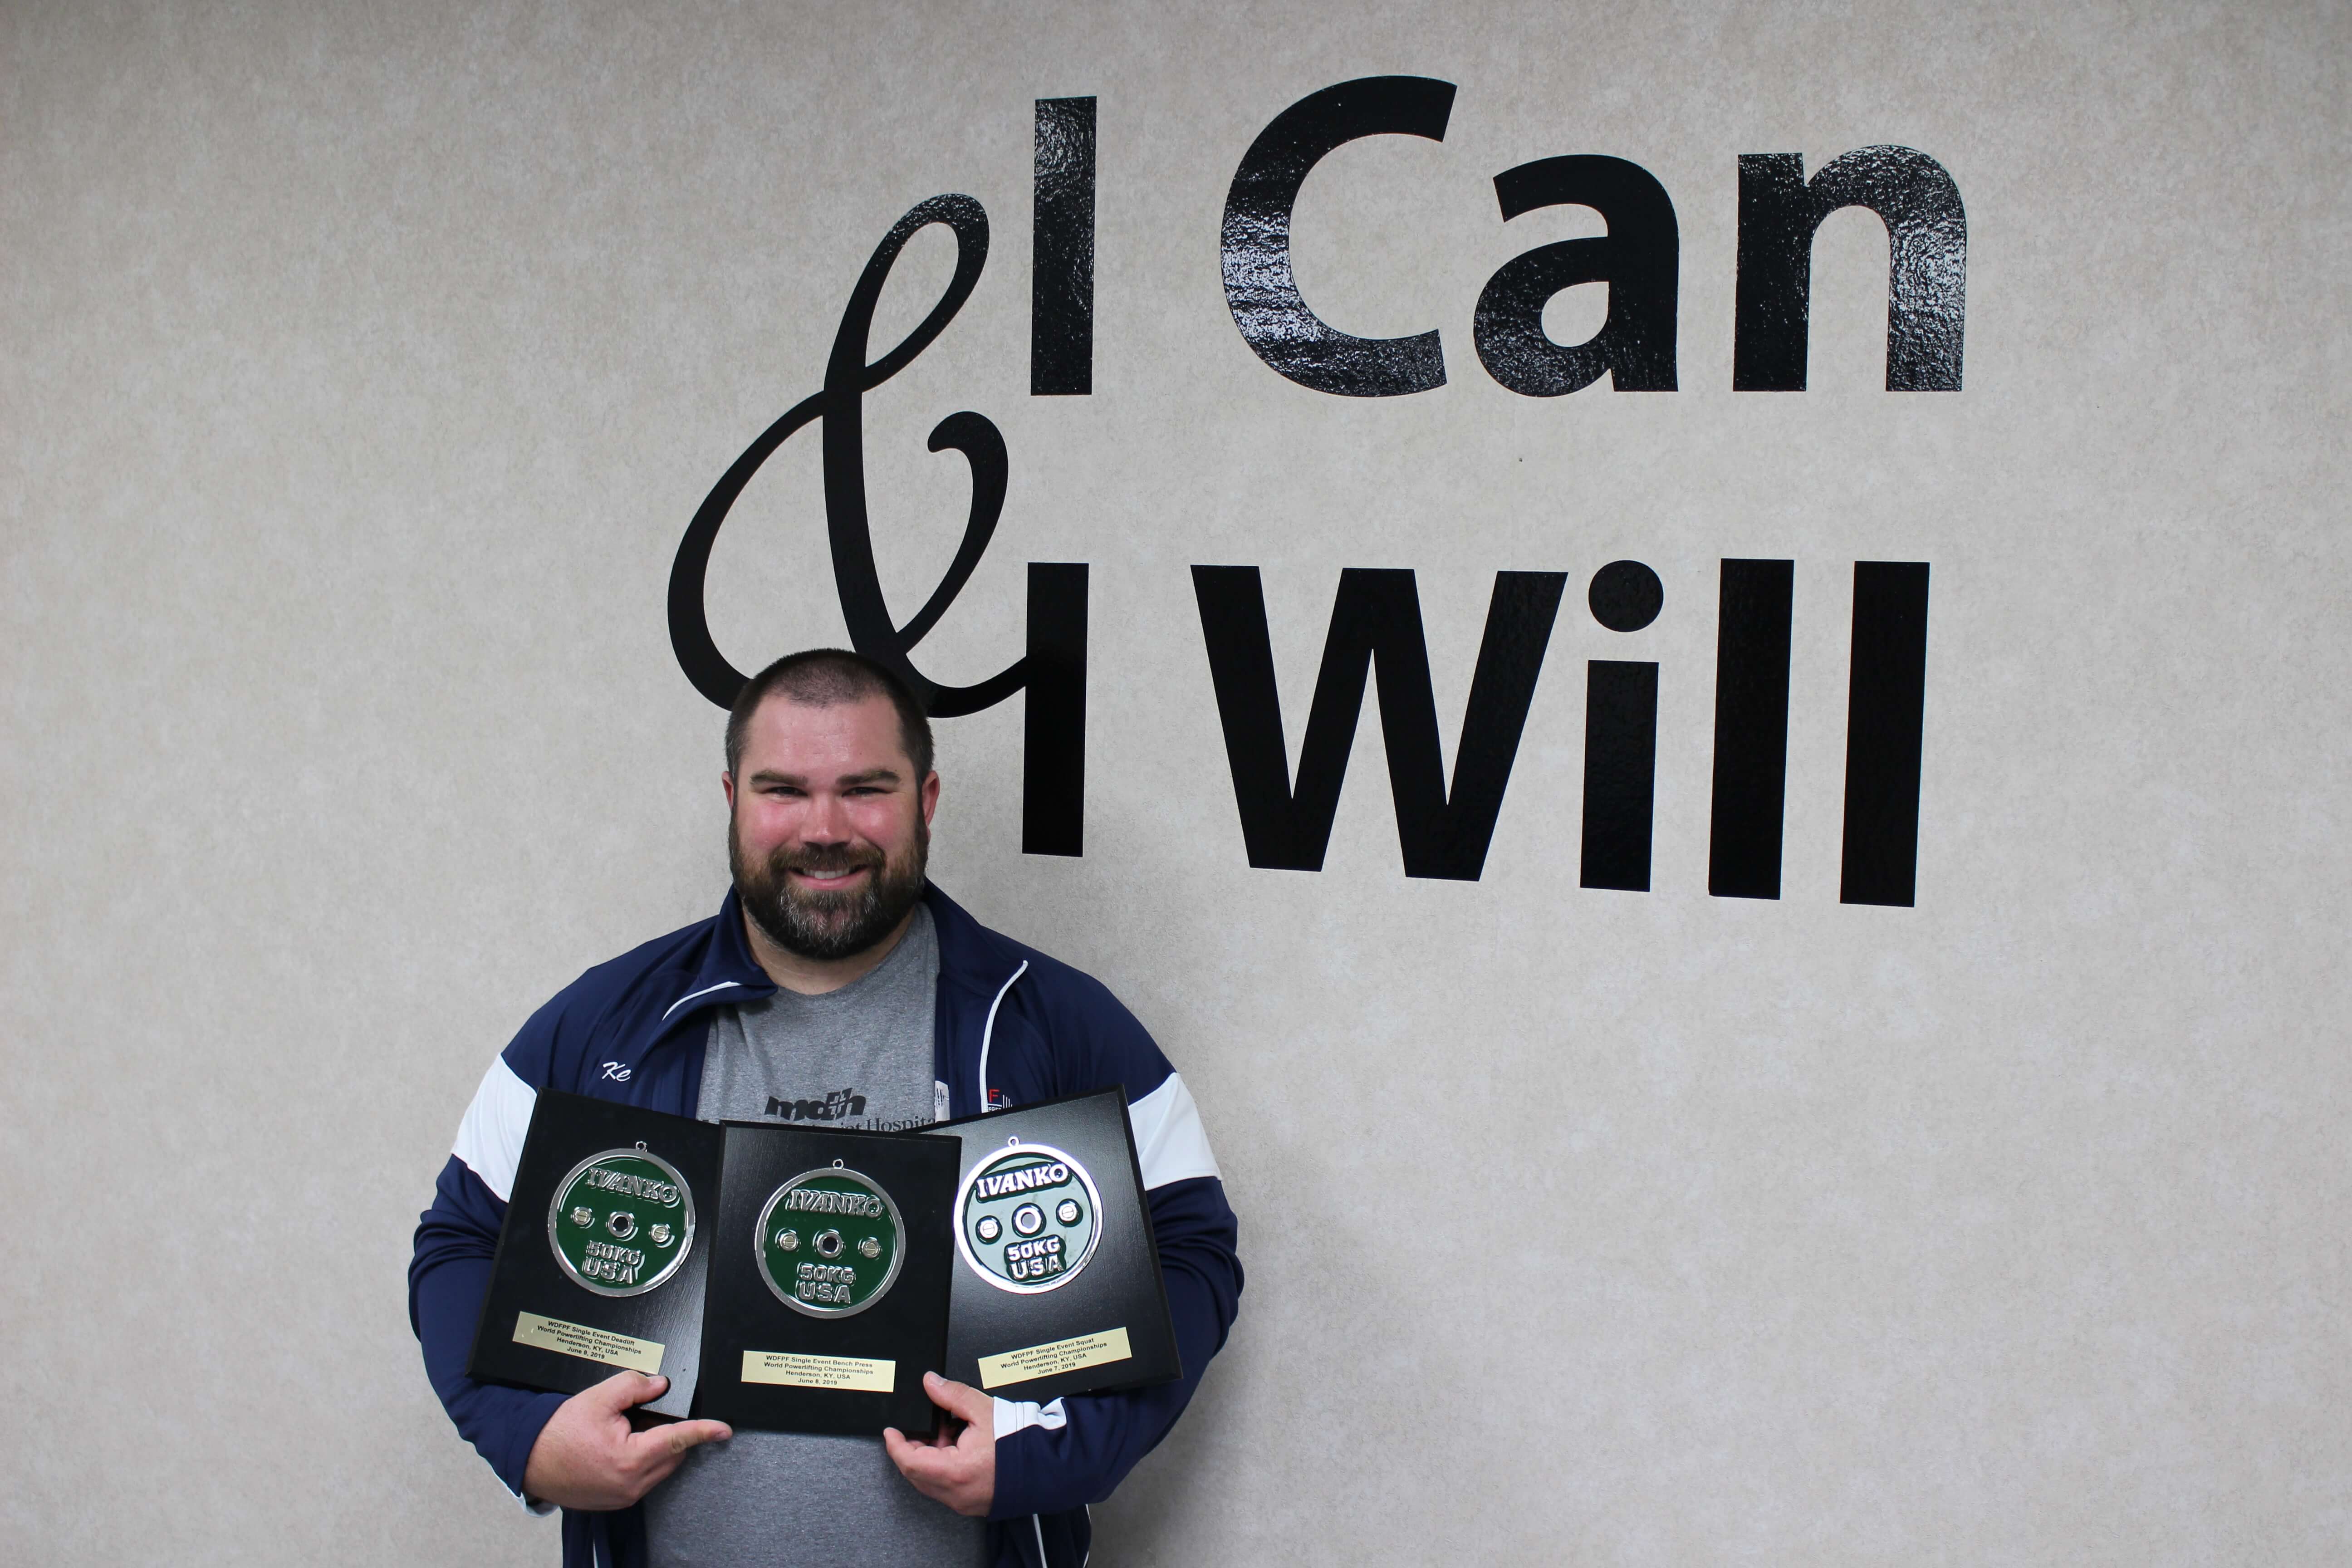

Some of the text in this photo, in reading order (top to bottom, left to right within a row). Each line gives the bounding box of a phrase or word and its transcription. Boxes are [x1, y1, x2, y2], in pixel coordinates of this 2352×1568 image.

[1031, 76, 1967, 397] I Can
[667, 194, 1028, 718] &
[1023, 559, 1930, 907] I Will
[602, 1062, 631, 1082] Ke
[585, 1166, 678, 1203] IVANKO
[977, 1163, 1068, 1198] IVANKO
[789, 1189, 883, 1218] IVANKO
[586, 1240, 641, 1265] 50KG
[1007, 1236, 1061, 1261] 50KG
[583, 1256, 633, 1284] USA
[799, 1263, 855, 1284] 50KG
[1010, 1254, 1064, 1279] USA
[798, 1281, 851, 1303] USA
[538, 1325, 642, 1354] World Powerlifting Championships
[548, 1321, 635, 1346] WDFPF Single Event Deadlift
[557, 1337, 591, 1350] Henderson,
[605, 1348, 618, 1356] USA
[1000, 1342, 1107, 1369] World Powerlifting Championships
[1011, 1338, 1094, 1360] WDFPF Single Event Squat
[784, 1363, 822, 1372] Powerlifting
[824, 1367, 874, 1375] Championships
[1024, 1360, 1059, 1371] Henderson,
